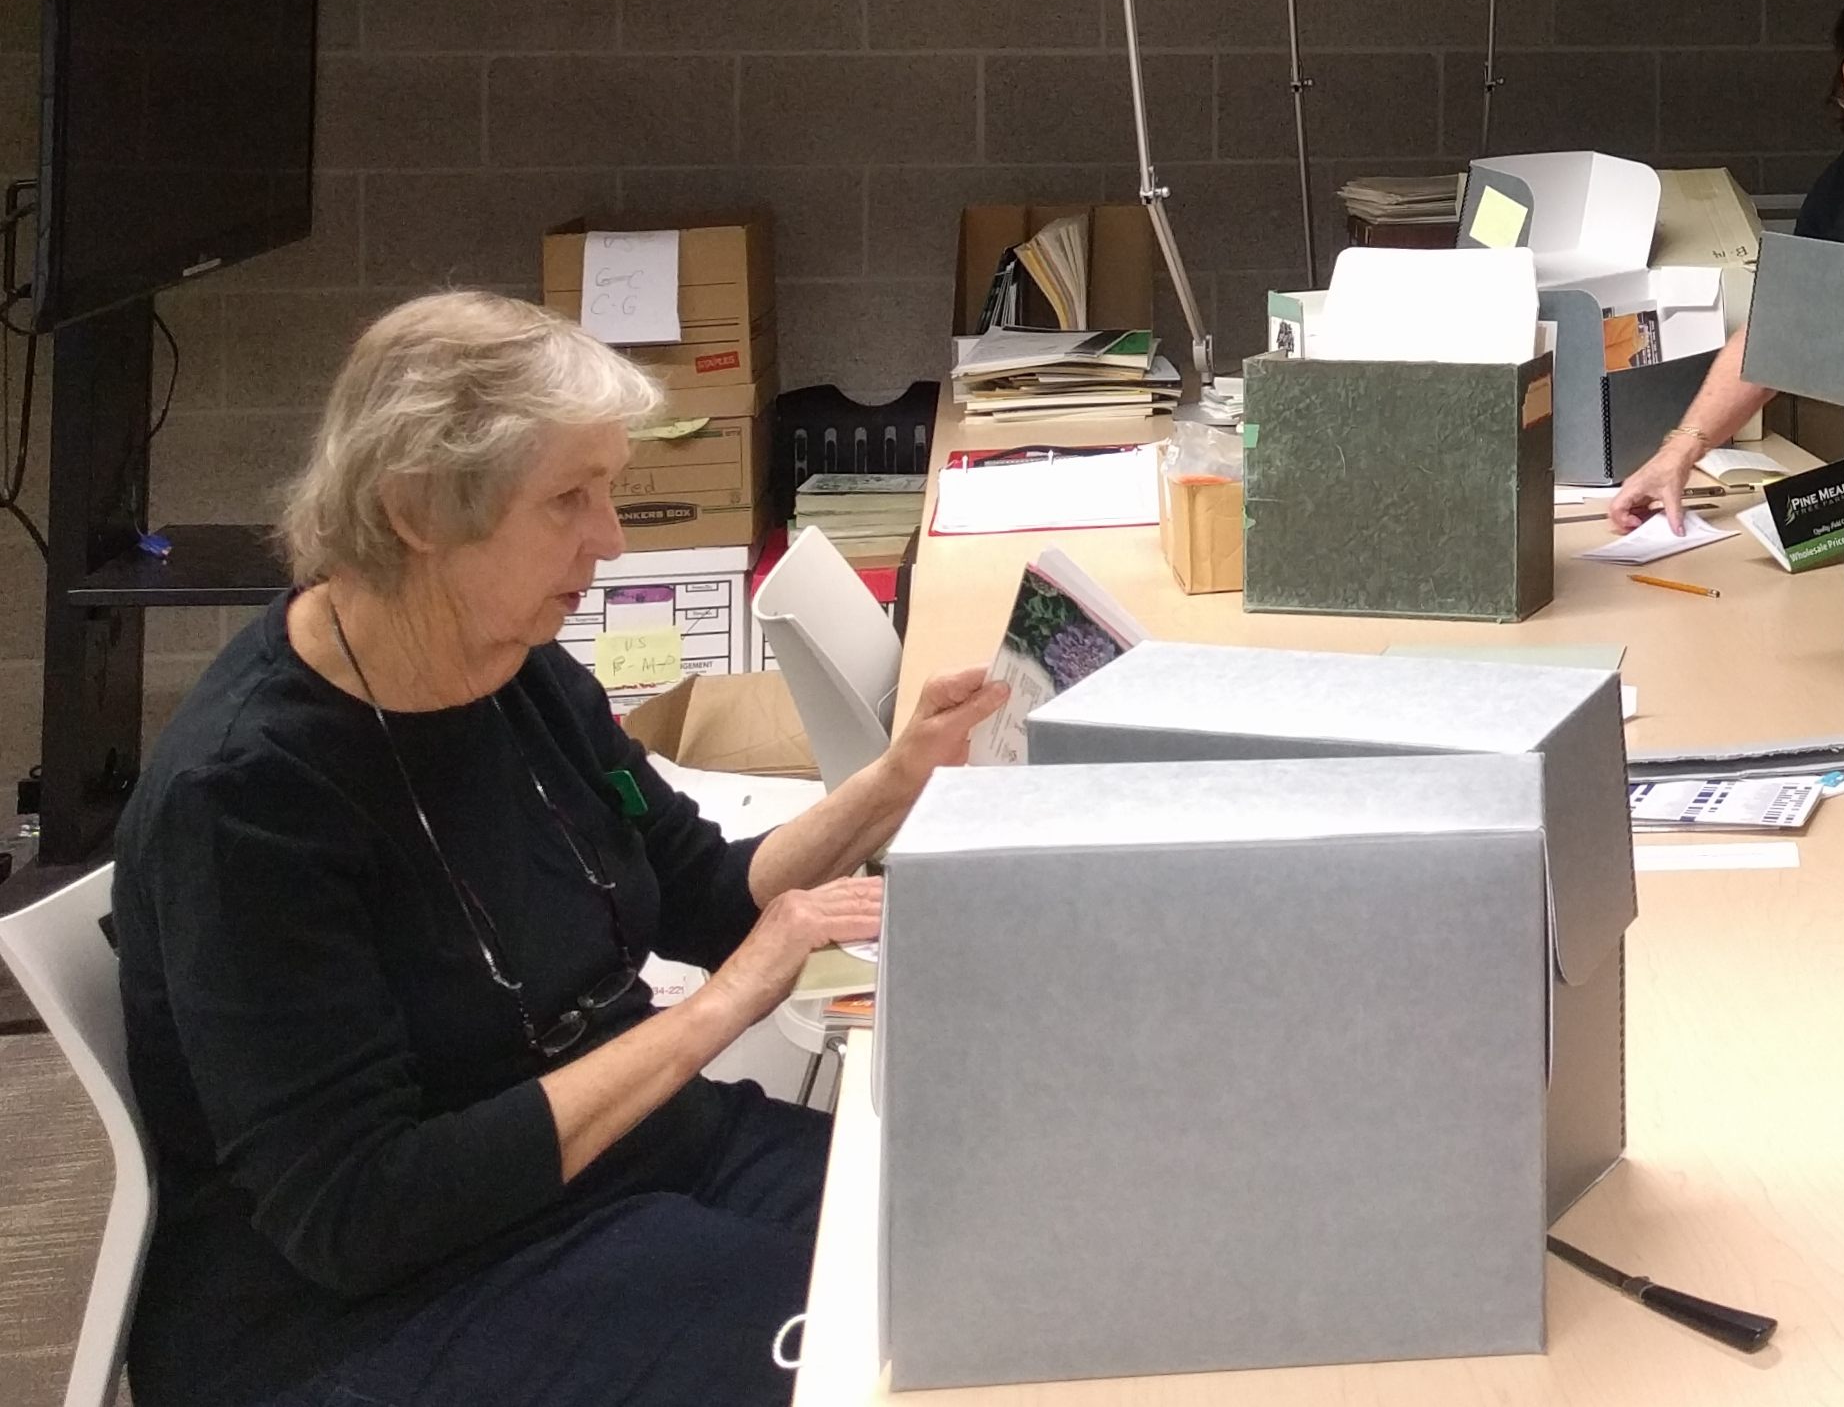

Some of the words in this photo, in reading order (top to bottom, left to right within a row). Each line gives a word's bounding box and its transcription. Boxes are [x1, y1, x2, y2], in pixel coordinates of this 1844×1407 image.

[697, 355, 735, 369] STAPLES
[1791, 493, 1819, 510] PINE
[618, 510, 663, 521] ANKERS
[667, 509, 691, 518] BOX
[1795, 504, 1821, 515] TREE
[1790, 542, 1828, 562] Wholesale
[681, 661, 713, 670] GEMENT
